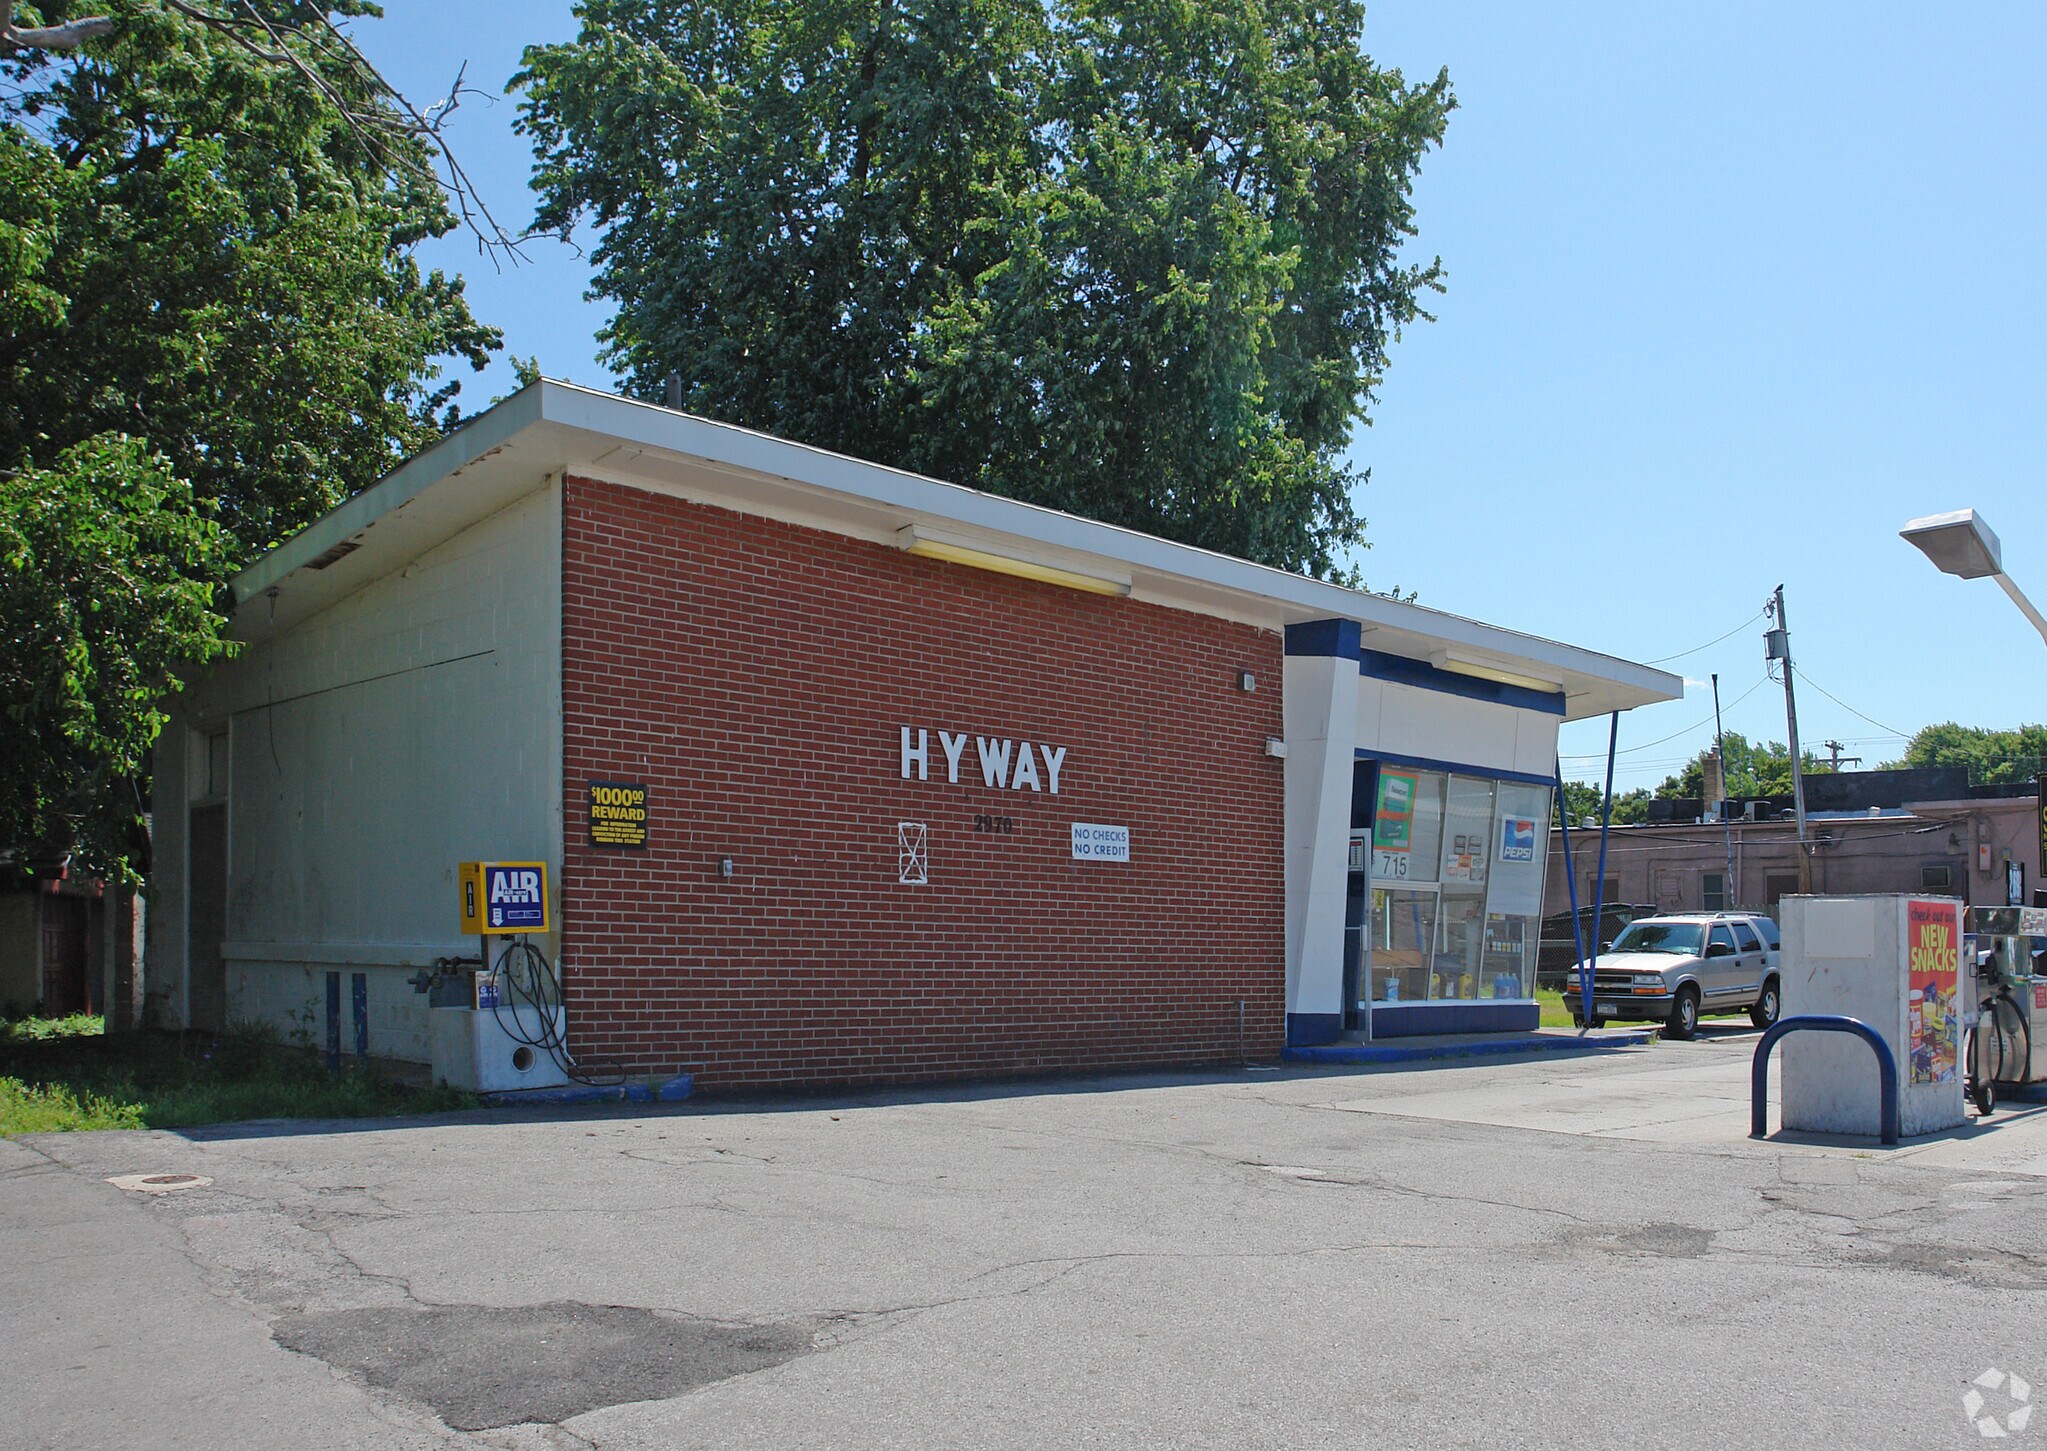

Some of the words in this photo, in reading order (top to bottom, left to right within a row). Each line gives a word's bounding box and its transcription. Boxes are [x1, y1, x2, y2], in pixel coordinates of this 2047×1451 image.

[901, 726, 1067, 794] HYWAY
[591, 804, 646, 821] REWARD
[1074, 828, 1090, 840] NO
[1092, 829, 1127, 842] CHECKS
[1074, 843, 1091, 855] NO
[1093, 844, 1127, 857] CREDIT
[1503, 846, 1532, 860] PEPSI
[467, 882, 475, 917] AIR
[490, 871, 540, 903] AIR
[1920, 923, 1949, 949] NEW
[1911, 946, 1957, 973] SNACKS
